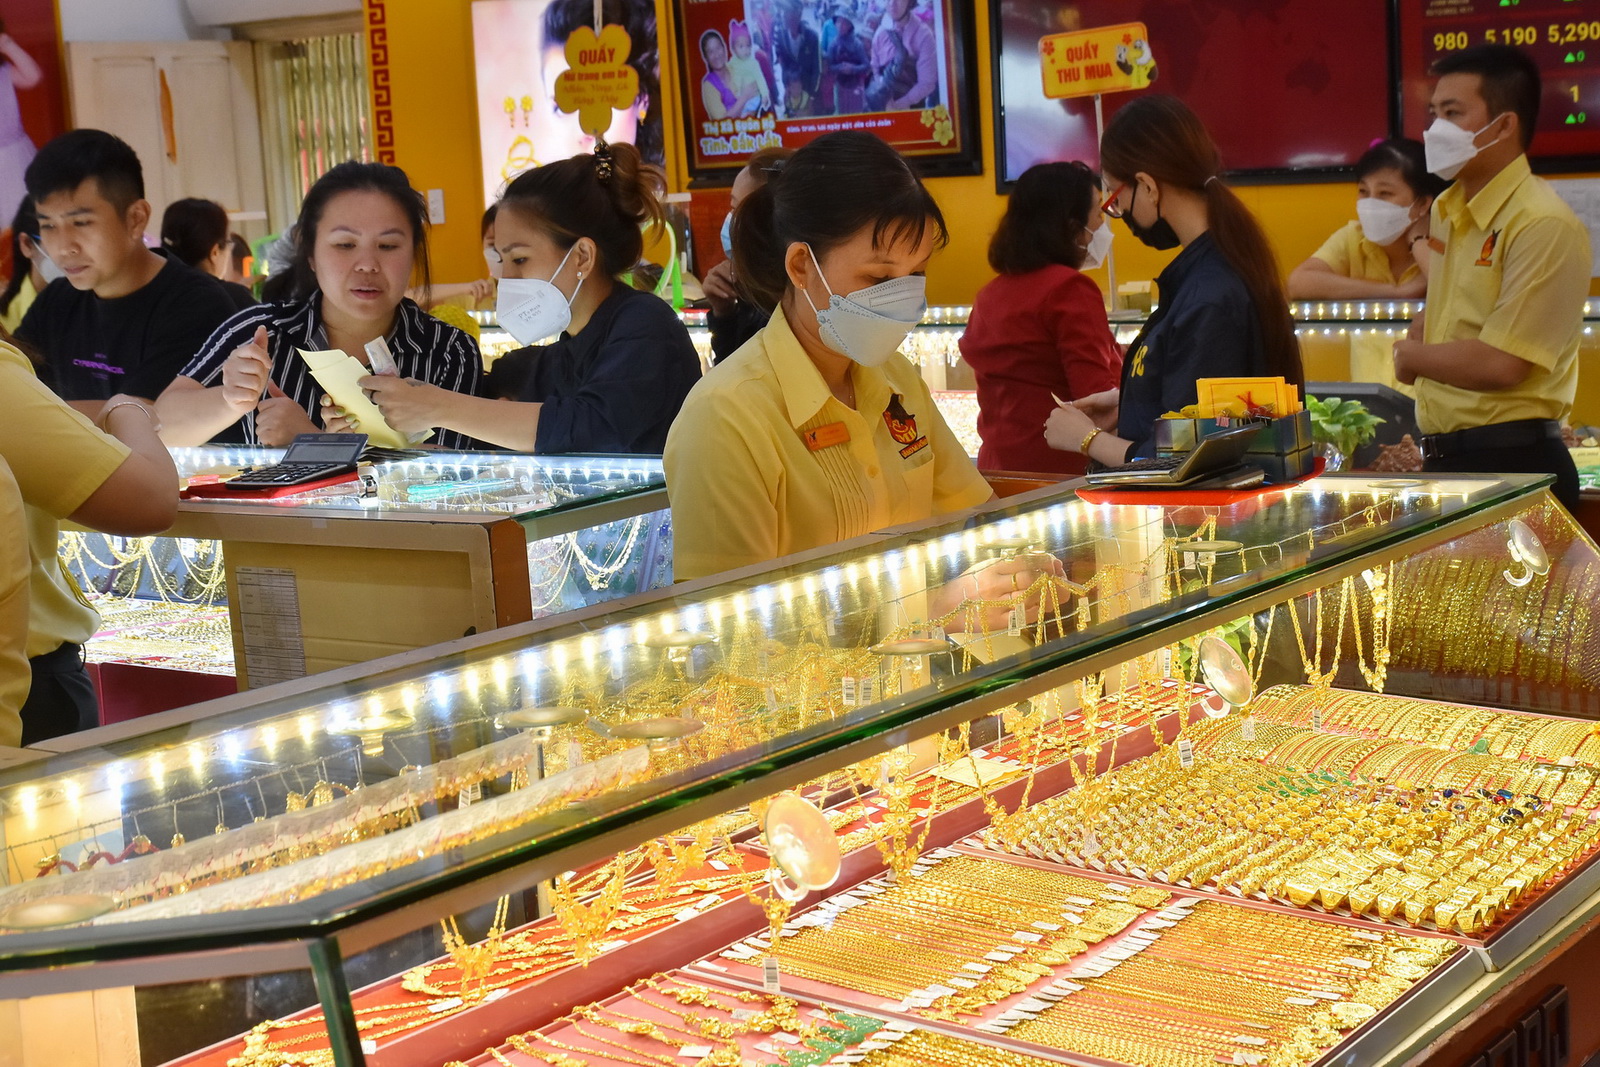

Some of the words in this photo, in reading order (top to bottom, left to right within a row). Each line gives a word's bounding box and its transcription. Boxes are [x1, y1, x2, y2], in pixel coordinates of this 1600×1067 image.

[1433, 31, 1469, 51] 980
[1548, 21, 1600, 46] 5,290
[1056, 66, 1081, 84] THU
[1084, 62, 1113, 80] MUA
